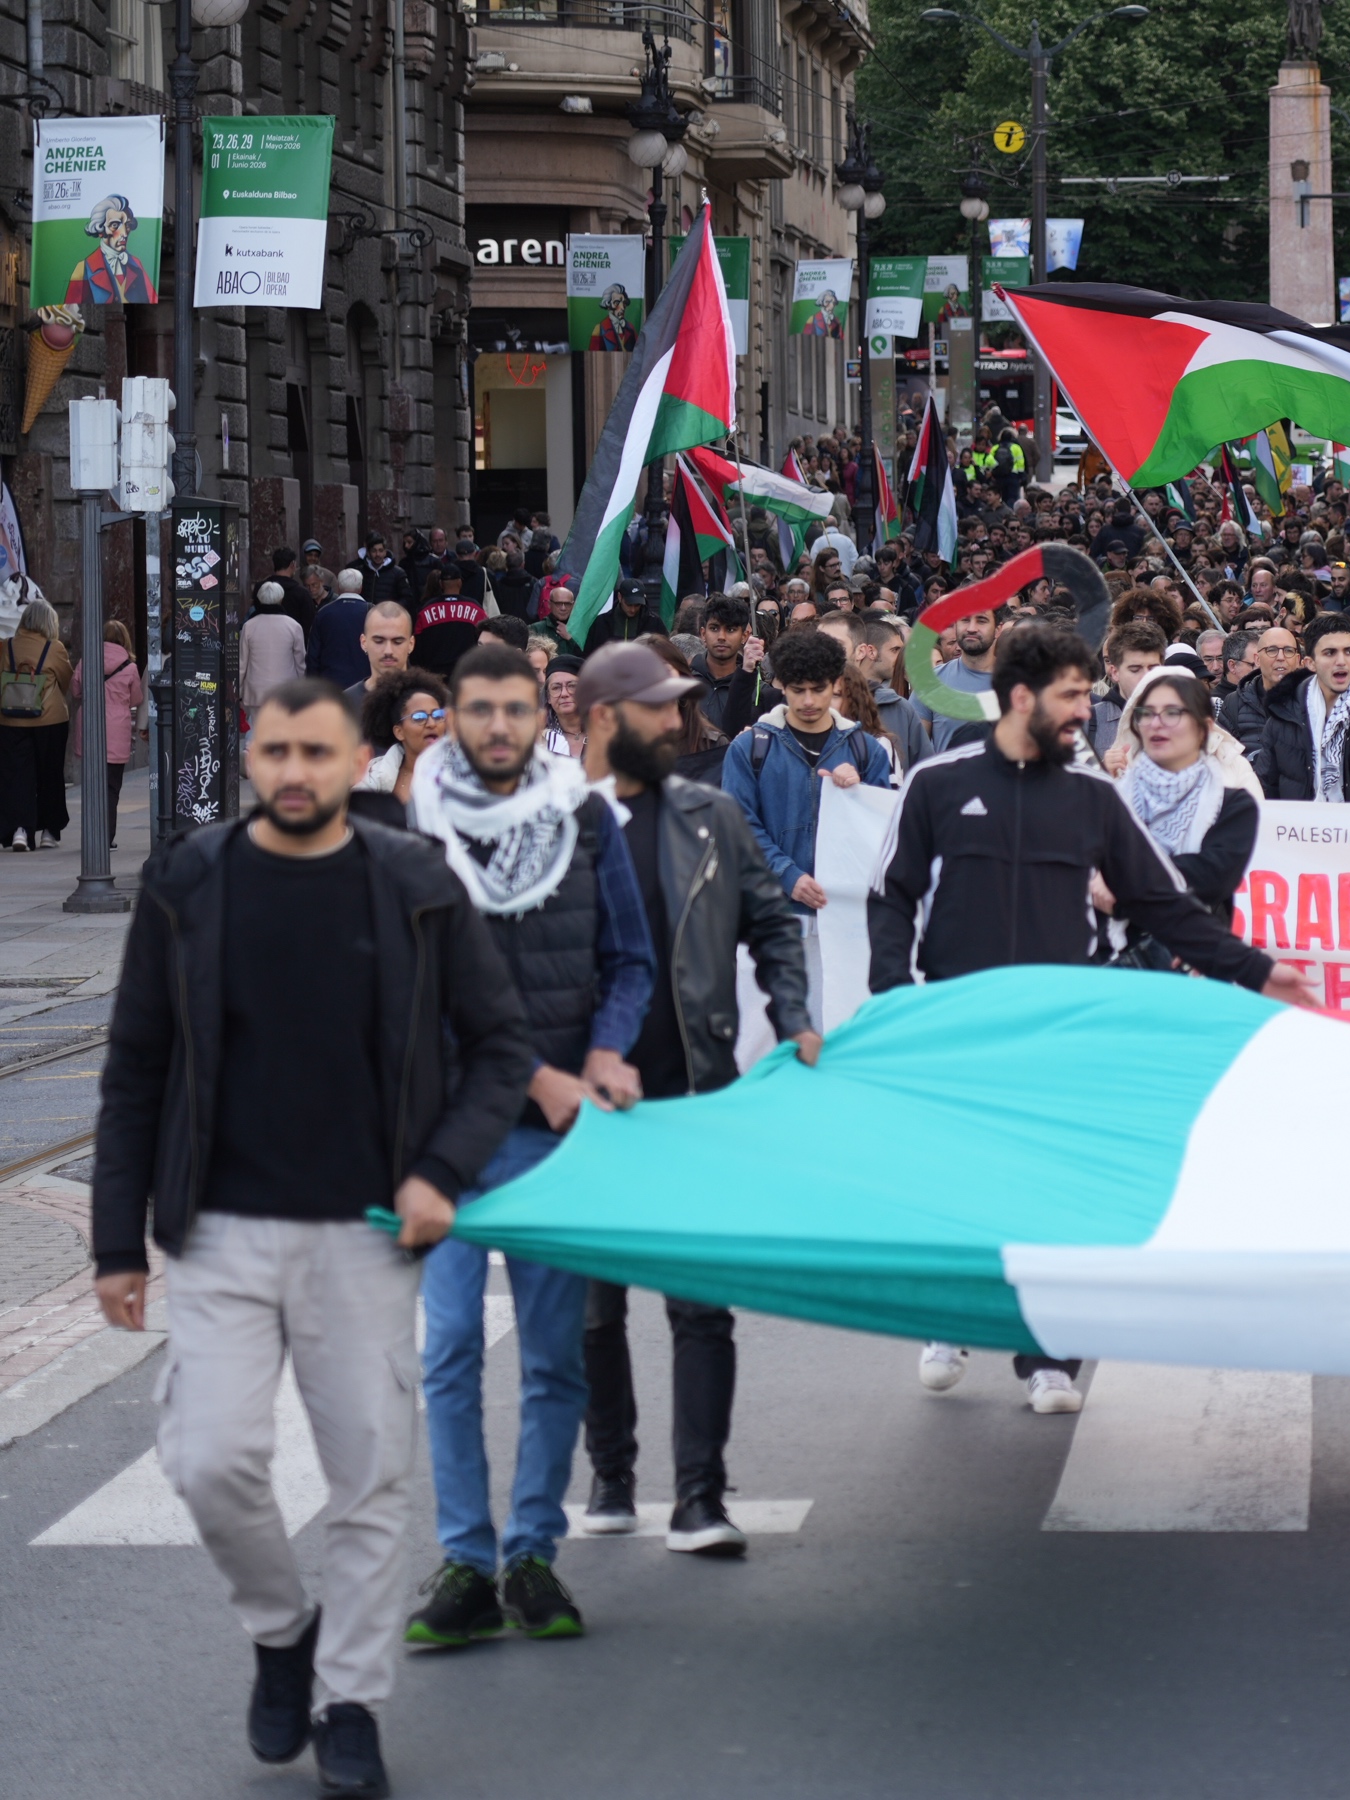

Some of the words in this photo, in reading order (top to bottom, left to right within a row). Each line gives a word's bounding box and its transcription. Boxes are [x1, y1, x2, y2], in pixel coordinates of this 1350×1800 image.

[45, 146, 103, 160] ANDREA
[265, 143, 283, 151] Mayo
[44, 158, 106, 174] CHÉNIER
[274, 191, 297, 199] Bilbao
[236, 249, 284, 258] kutxabank
[573, 251, 609, 260] ANDREA
[216, 271, 261, 294] ABAO
[267, 272, 290, 284] BILBAO
[266, 284, 287, 296] OPERA
[424, 605, 446, 624] NEW
[450, 604, 478, 622] YORK
